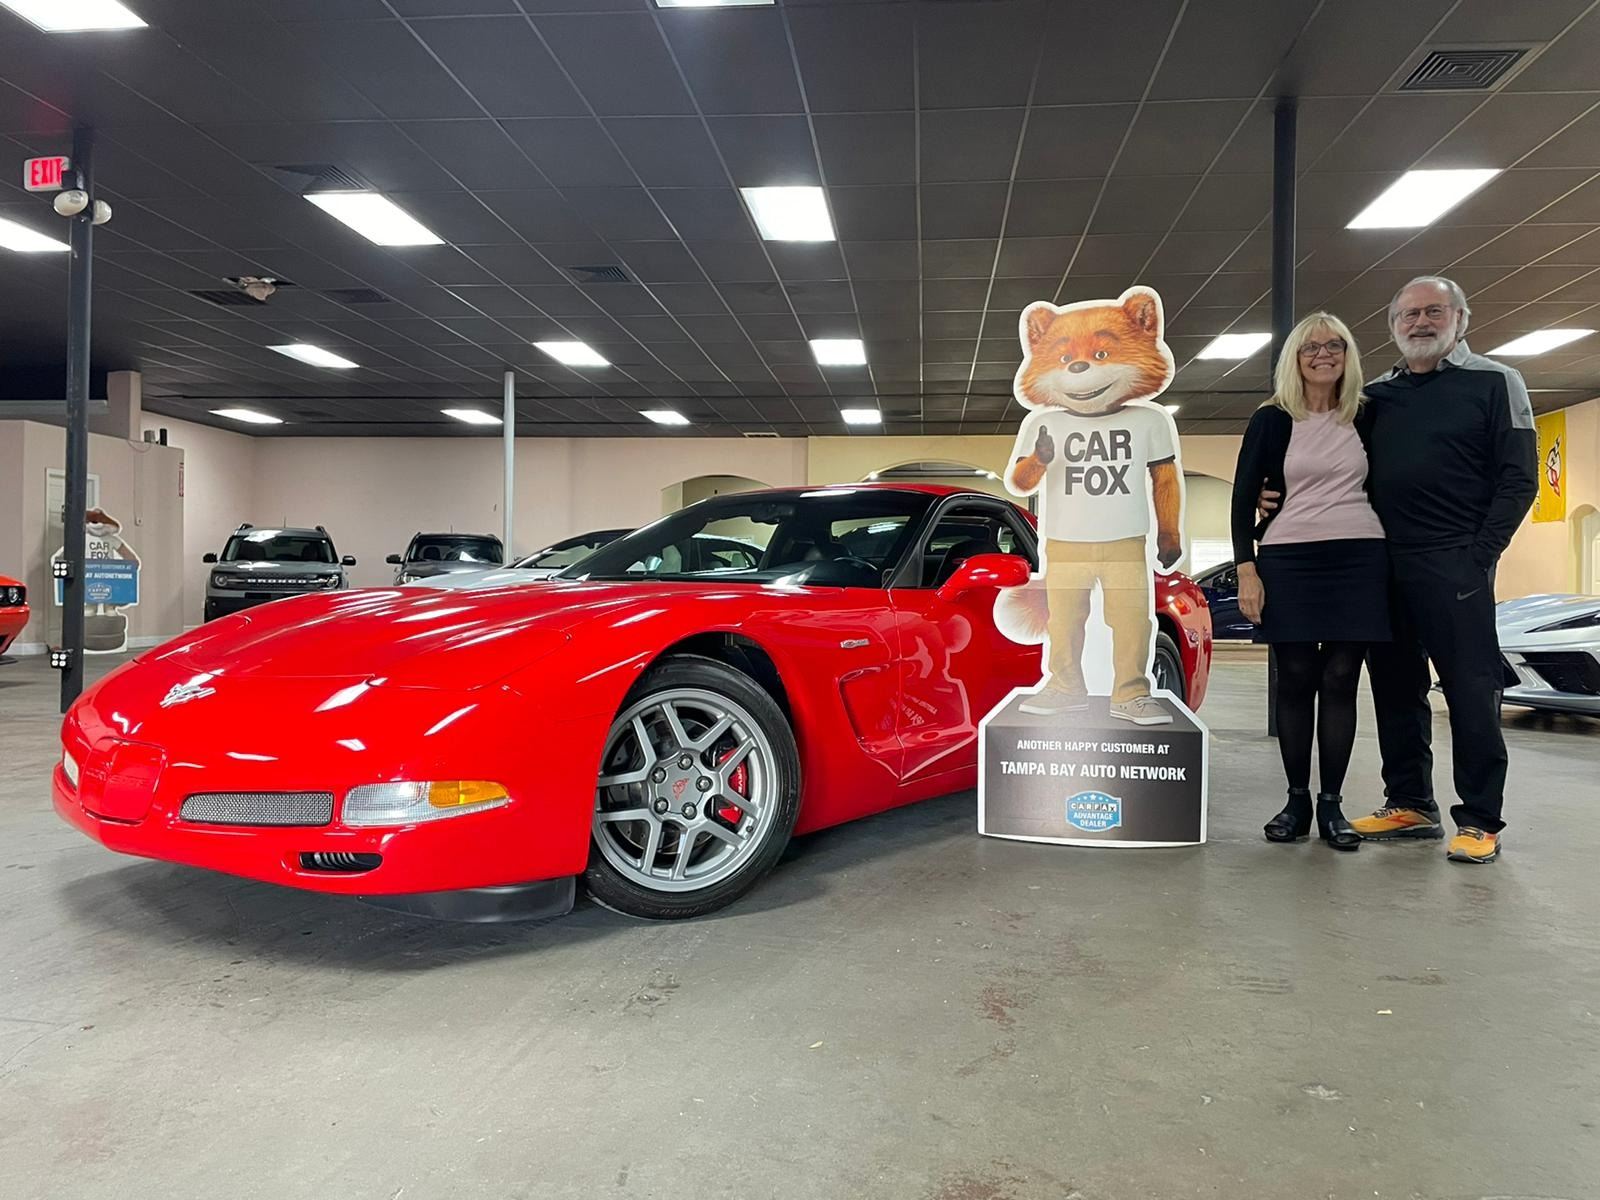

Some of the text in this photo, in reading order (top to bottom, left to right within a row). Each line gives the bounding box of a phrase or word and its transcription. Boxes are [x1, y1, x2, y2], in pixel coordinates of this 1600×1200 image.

[31, 159, 62, 186] EXIT
[1063, 429, 1132, 462] CAR
[1065, 464, 1130, 496] FOX
[89, 542, 110, 551] CAR
[91, 551, 109, 559] FOX
[1017, 740, 1170, 755] ANOTHER HAPPY CUSTOMER AT
[1001, 761, 1187, 781] TAMPA BAY AUTO NETWORK
[1070, 803, 1117, 812] CARFAX
[1073, 812, 1113, 820] ADVANTAGE
[1080, 819, 1107, 828] DEALER
